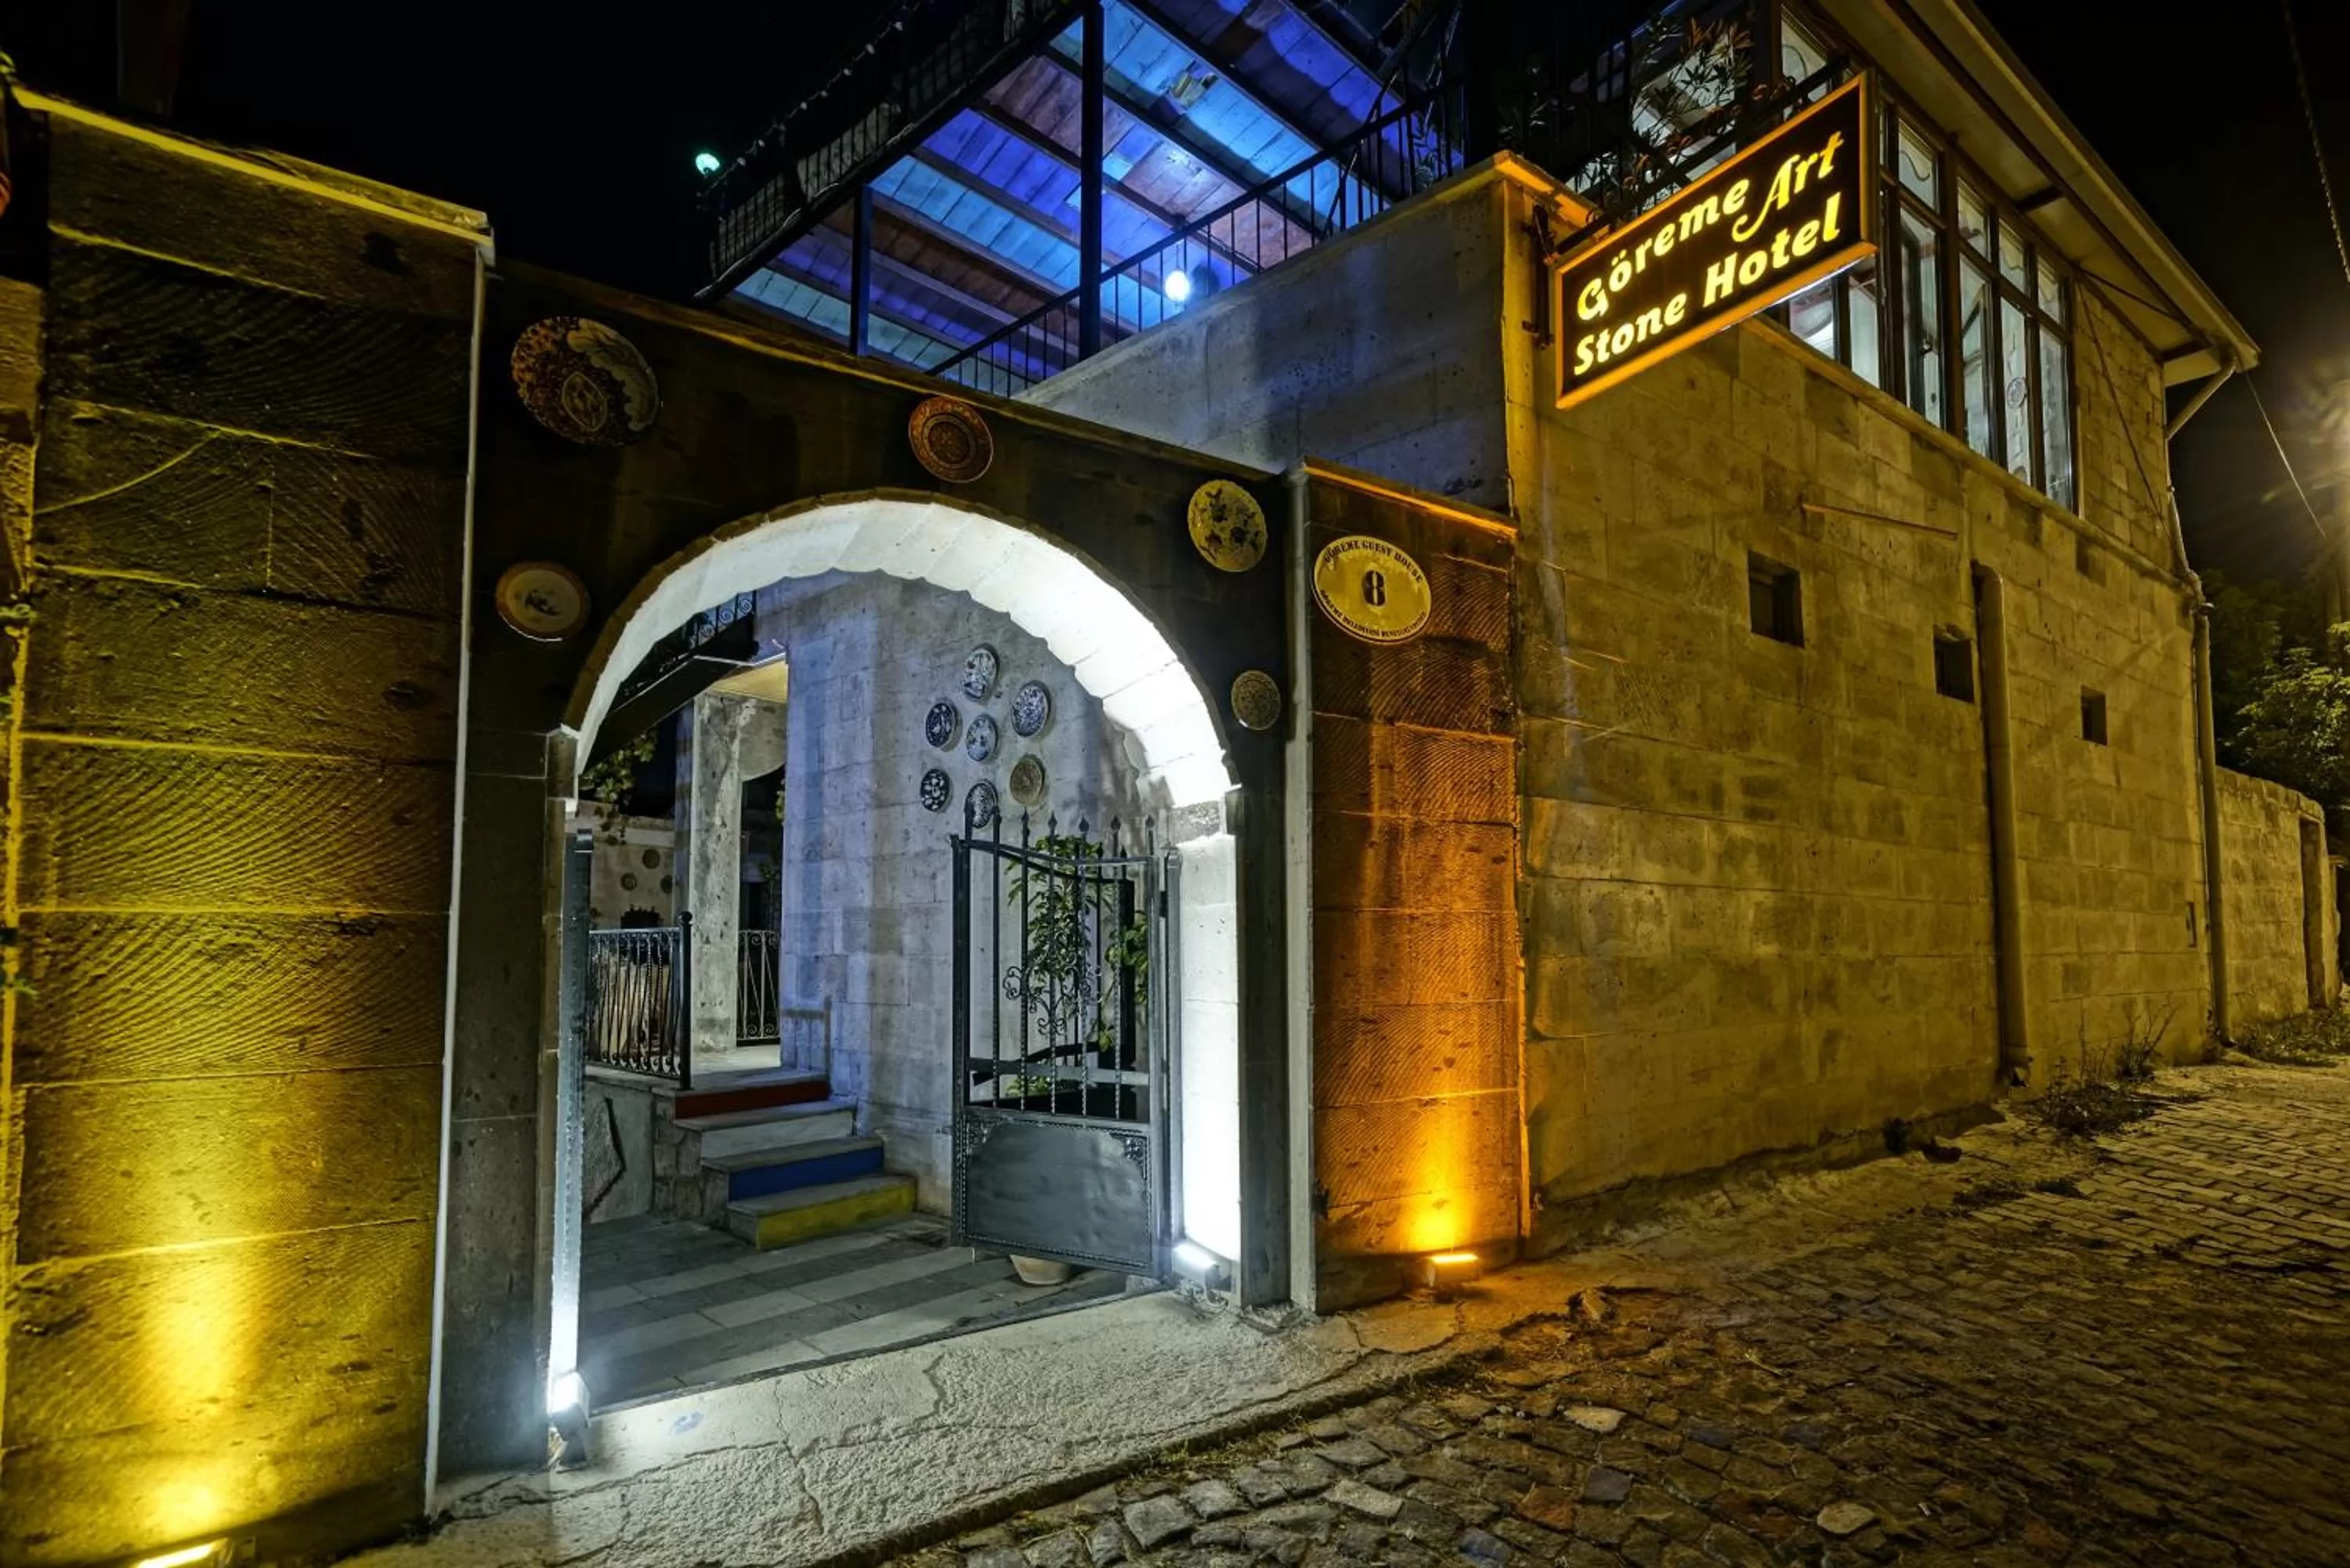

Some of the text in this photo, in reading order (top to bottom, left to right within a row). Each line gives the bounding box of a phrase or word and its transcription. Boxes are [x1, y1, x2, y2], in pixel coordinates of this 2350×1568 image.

[1574, 192, 1842, 376] Stone Hotel
[1576, 130, 1844, 322] Göreme Art
[1362, 540, 1391, 557] GUEST
